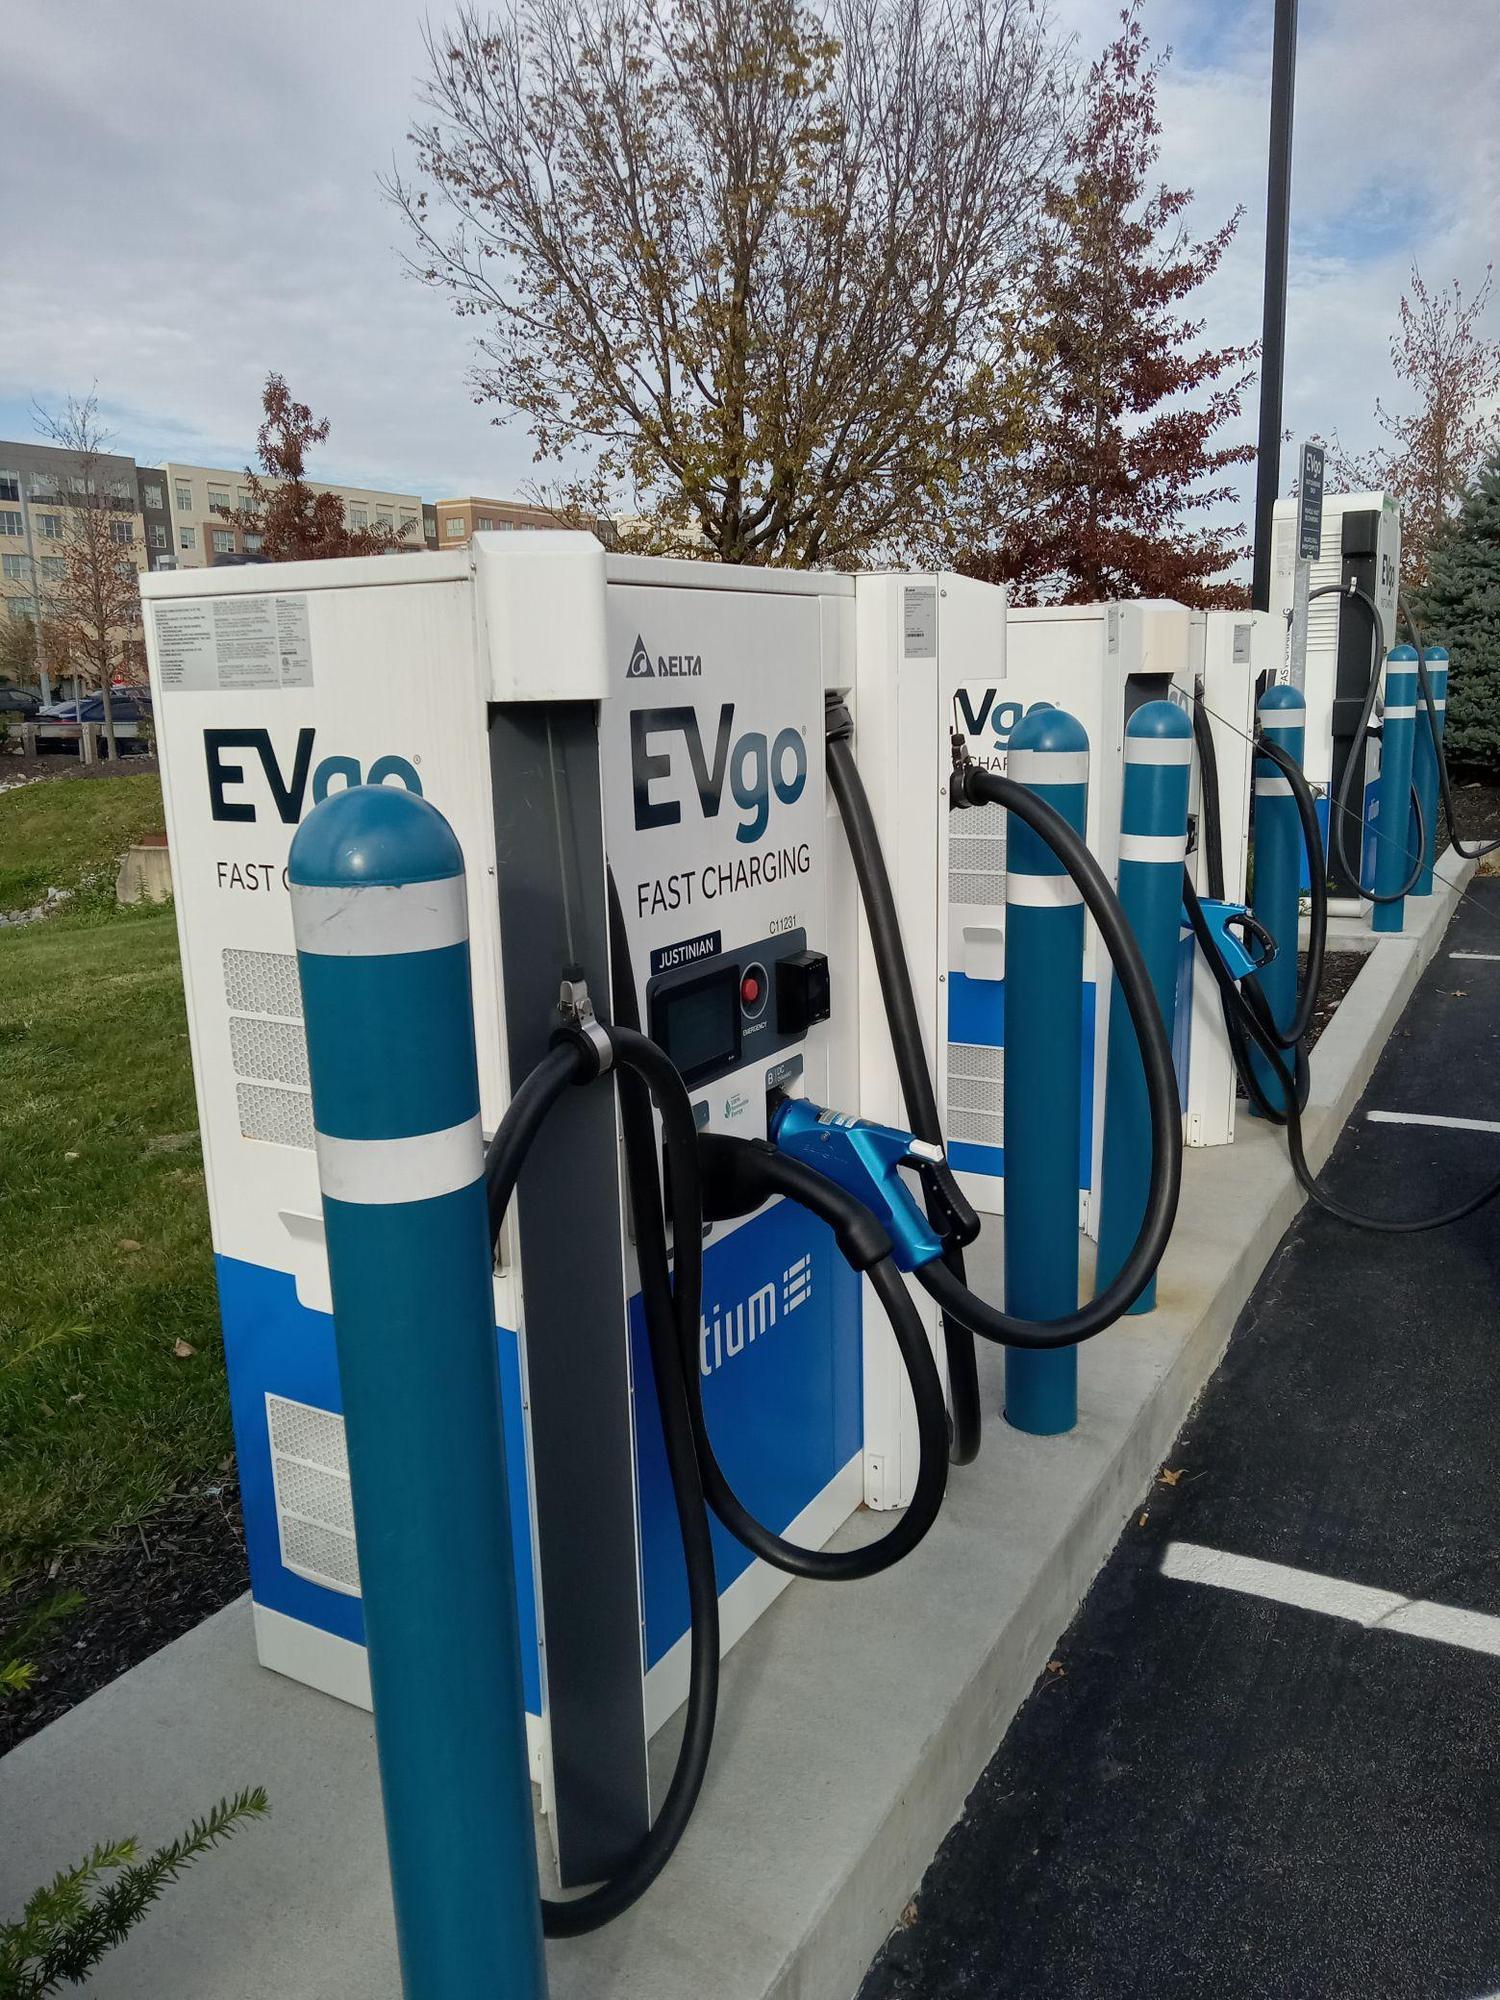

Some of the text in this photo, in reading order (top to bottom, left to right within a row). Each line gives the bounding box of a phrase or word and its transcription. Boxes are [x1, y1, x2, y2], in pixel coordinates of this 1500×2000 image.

[658, 656, 702, 677] DELTA
[630, 703, 807, 843] EVgo
[217, 862, 274, 892] FAST
[637, 843, 810, 918] FAST CHARGING
[769, 915, 797, 935] C11231
[659, 937, 714, 969] JUSTINIAN
[742, 1021, 767, 1037] EMERGENCY
